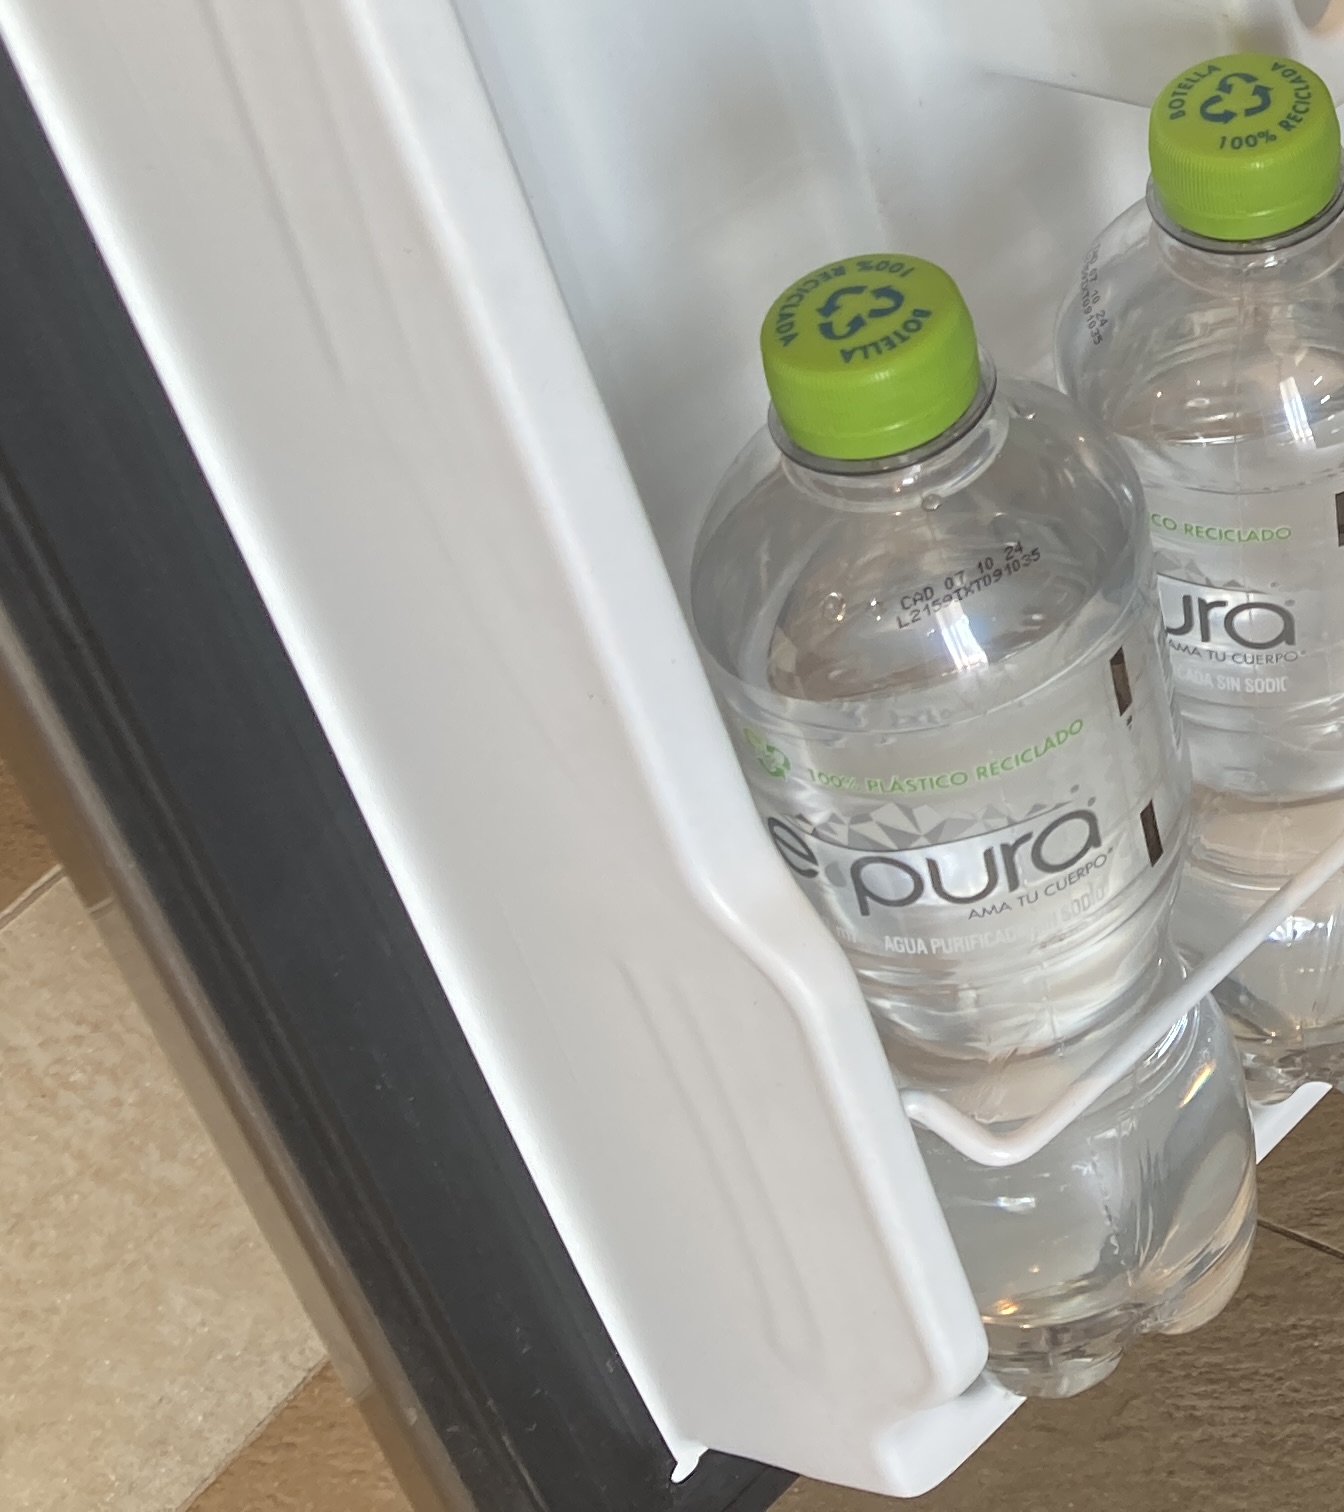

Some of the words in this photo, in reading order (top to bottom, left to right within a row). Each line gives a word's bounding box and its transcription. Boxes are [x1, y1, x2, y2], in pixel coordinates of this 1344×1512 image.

[1168, 64, 1222, 121] BOTELLA
[1219, 129, 1278, 151] 100%
[1270, 61, 1312, 133] RECICLADA
[855, 259, 916, 278] 100%
[776, 264, 847, 348] RECICLADA
[839, 308, 933, 364] BOTELLA
[1183, 522, 1293, 543] RECICLADO
[900, 586, 935, 611] CAD
[943, 570, 966, 591] 07
[976, 556, 995, 575] 10
[1003, 540, 1024, 562] 24
[1168, 638, 1202, 659] AMA
[1207, 649, 1227, 663] TU
[1231, 650, 1299, 666] CUERPO
[1216, 674, 1241, 693] SIN
[975, 718, 1084, 780] RECICLADO
[967, 902, 1012, 921] AMA
[1017, 891, 1039, 908] TU
[1043, 853, 1108, 898] CUERPO
[884, 935, 928, 955] AGUA
[930, 927, 1018, 955] PURIFICAD
